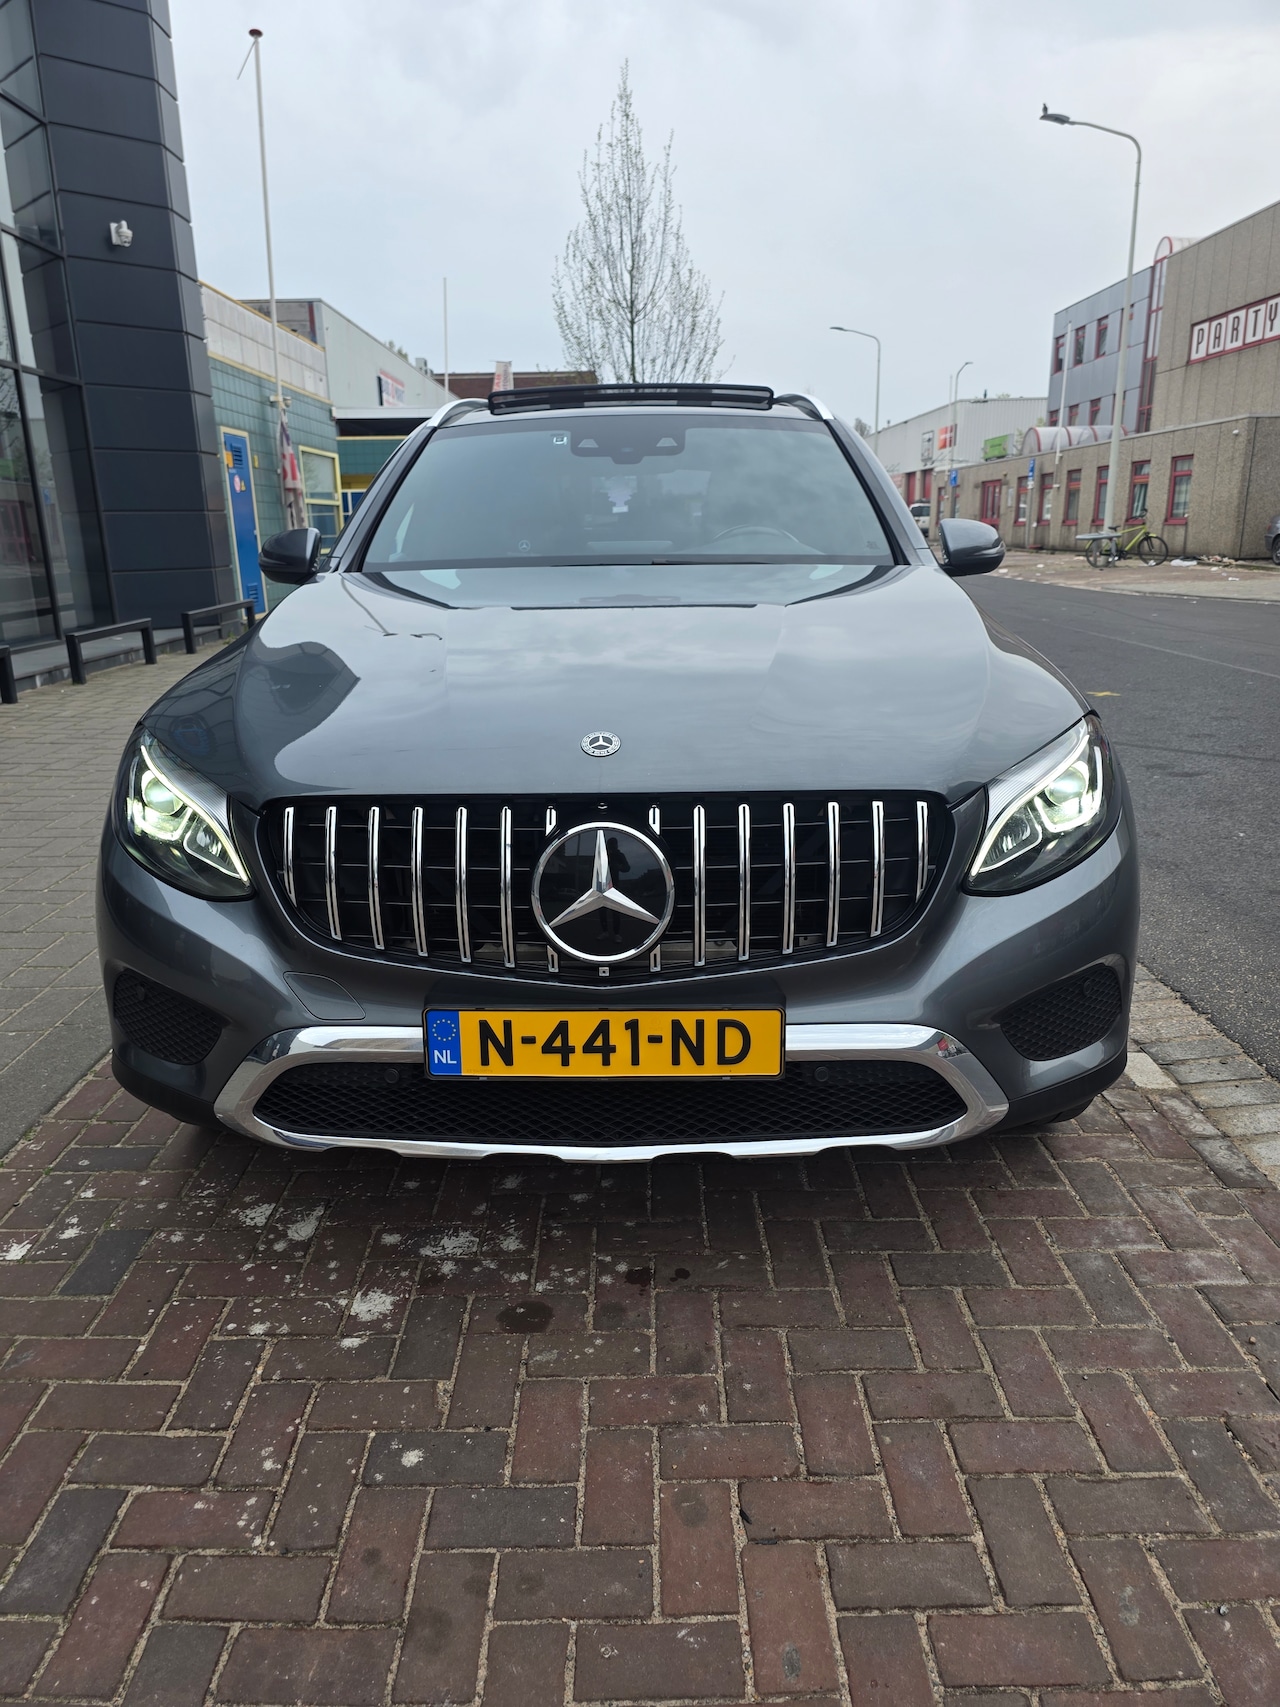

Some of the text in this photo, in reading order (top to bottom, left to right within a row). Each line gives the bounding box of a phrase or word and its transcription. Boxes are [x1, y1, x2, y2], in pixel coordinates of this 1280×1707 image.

[1195, 302, 1279, 354] PARTY
[433, 1049, 457, 1064] NL
[478, 1019, 752, 1067] N-441-ND
